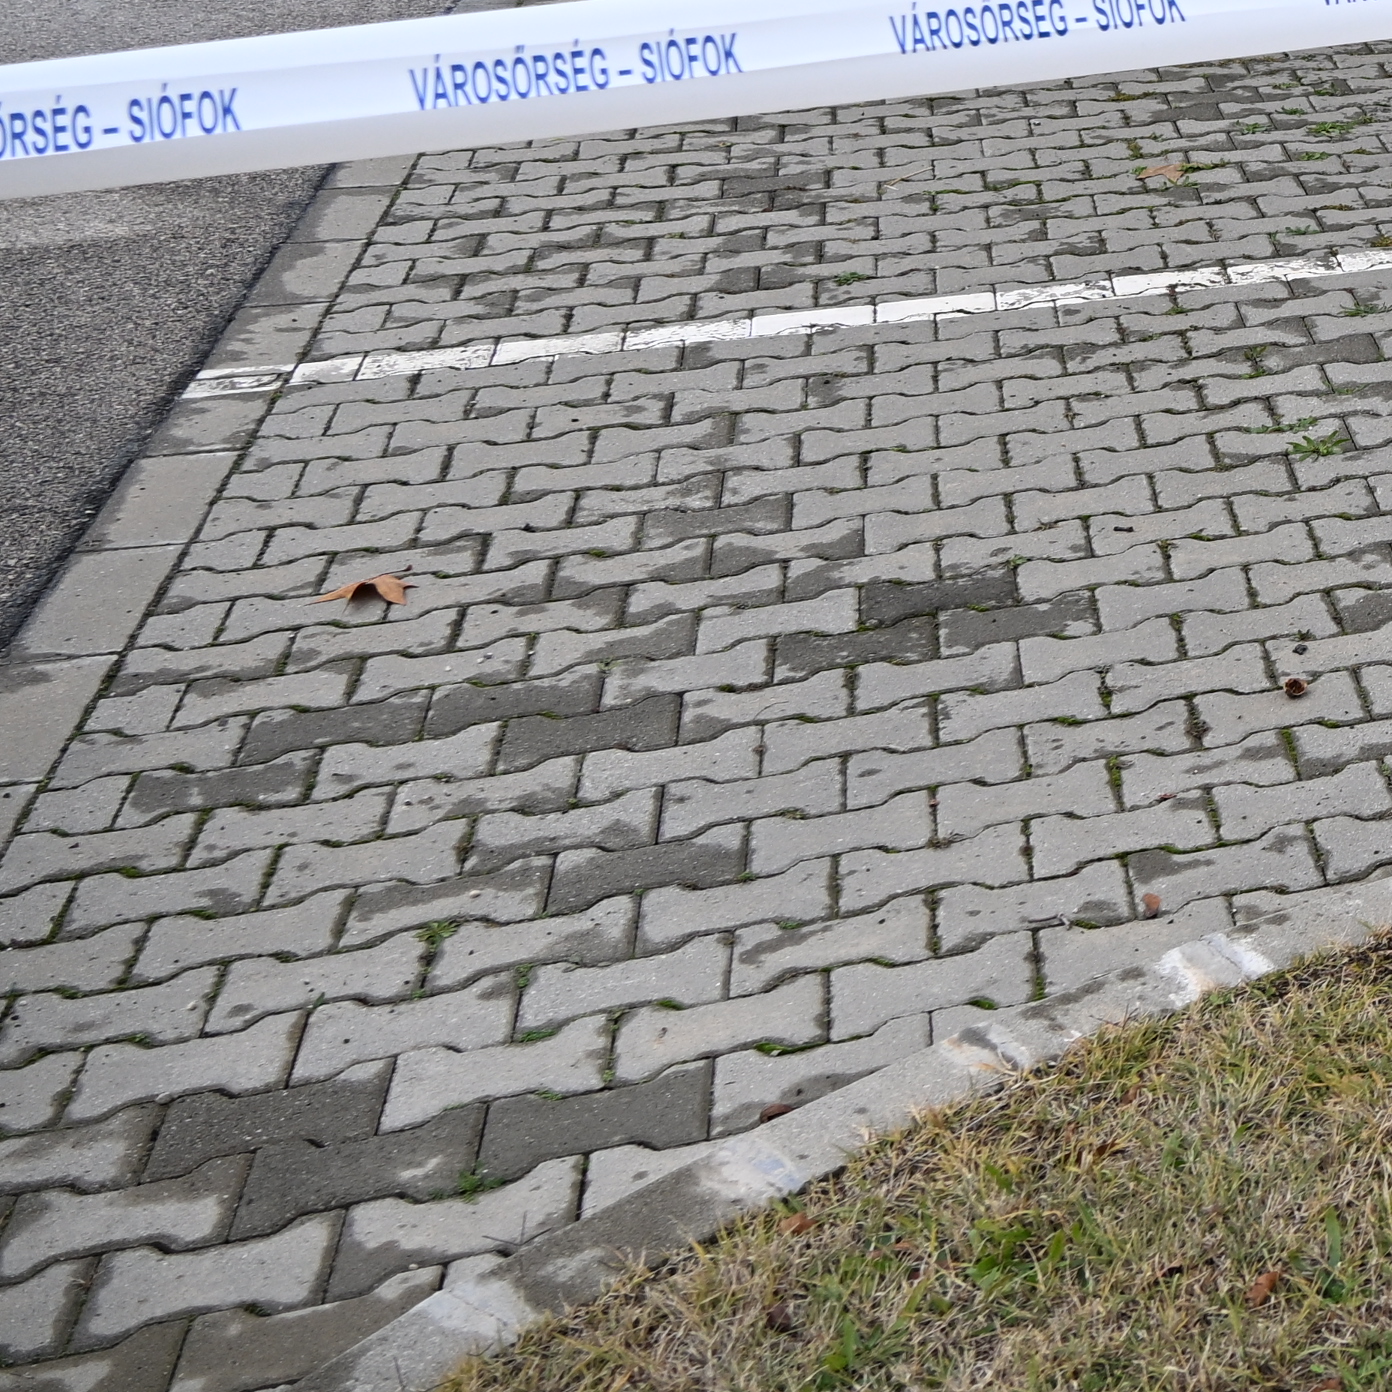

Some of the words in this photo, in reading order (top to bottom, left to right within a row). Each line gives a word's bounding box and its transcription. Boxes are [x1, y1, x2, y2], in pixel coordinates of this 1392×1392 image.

[409, 39, 609, 110] VÁROSŐRSÉG
[640, 28, 743, 84] SIÓFOK
[128, 83, 241, 143] SIÓFOK
